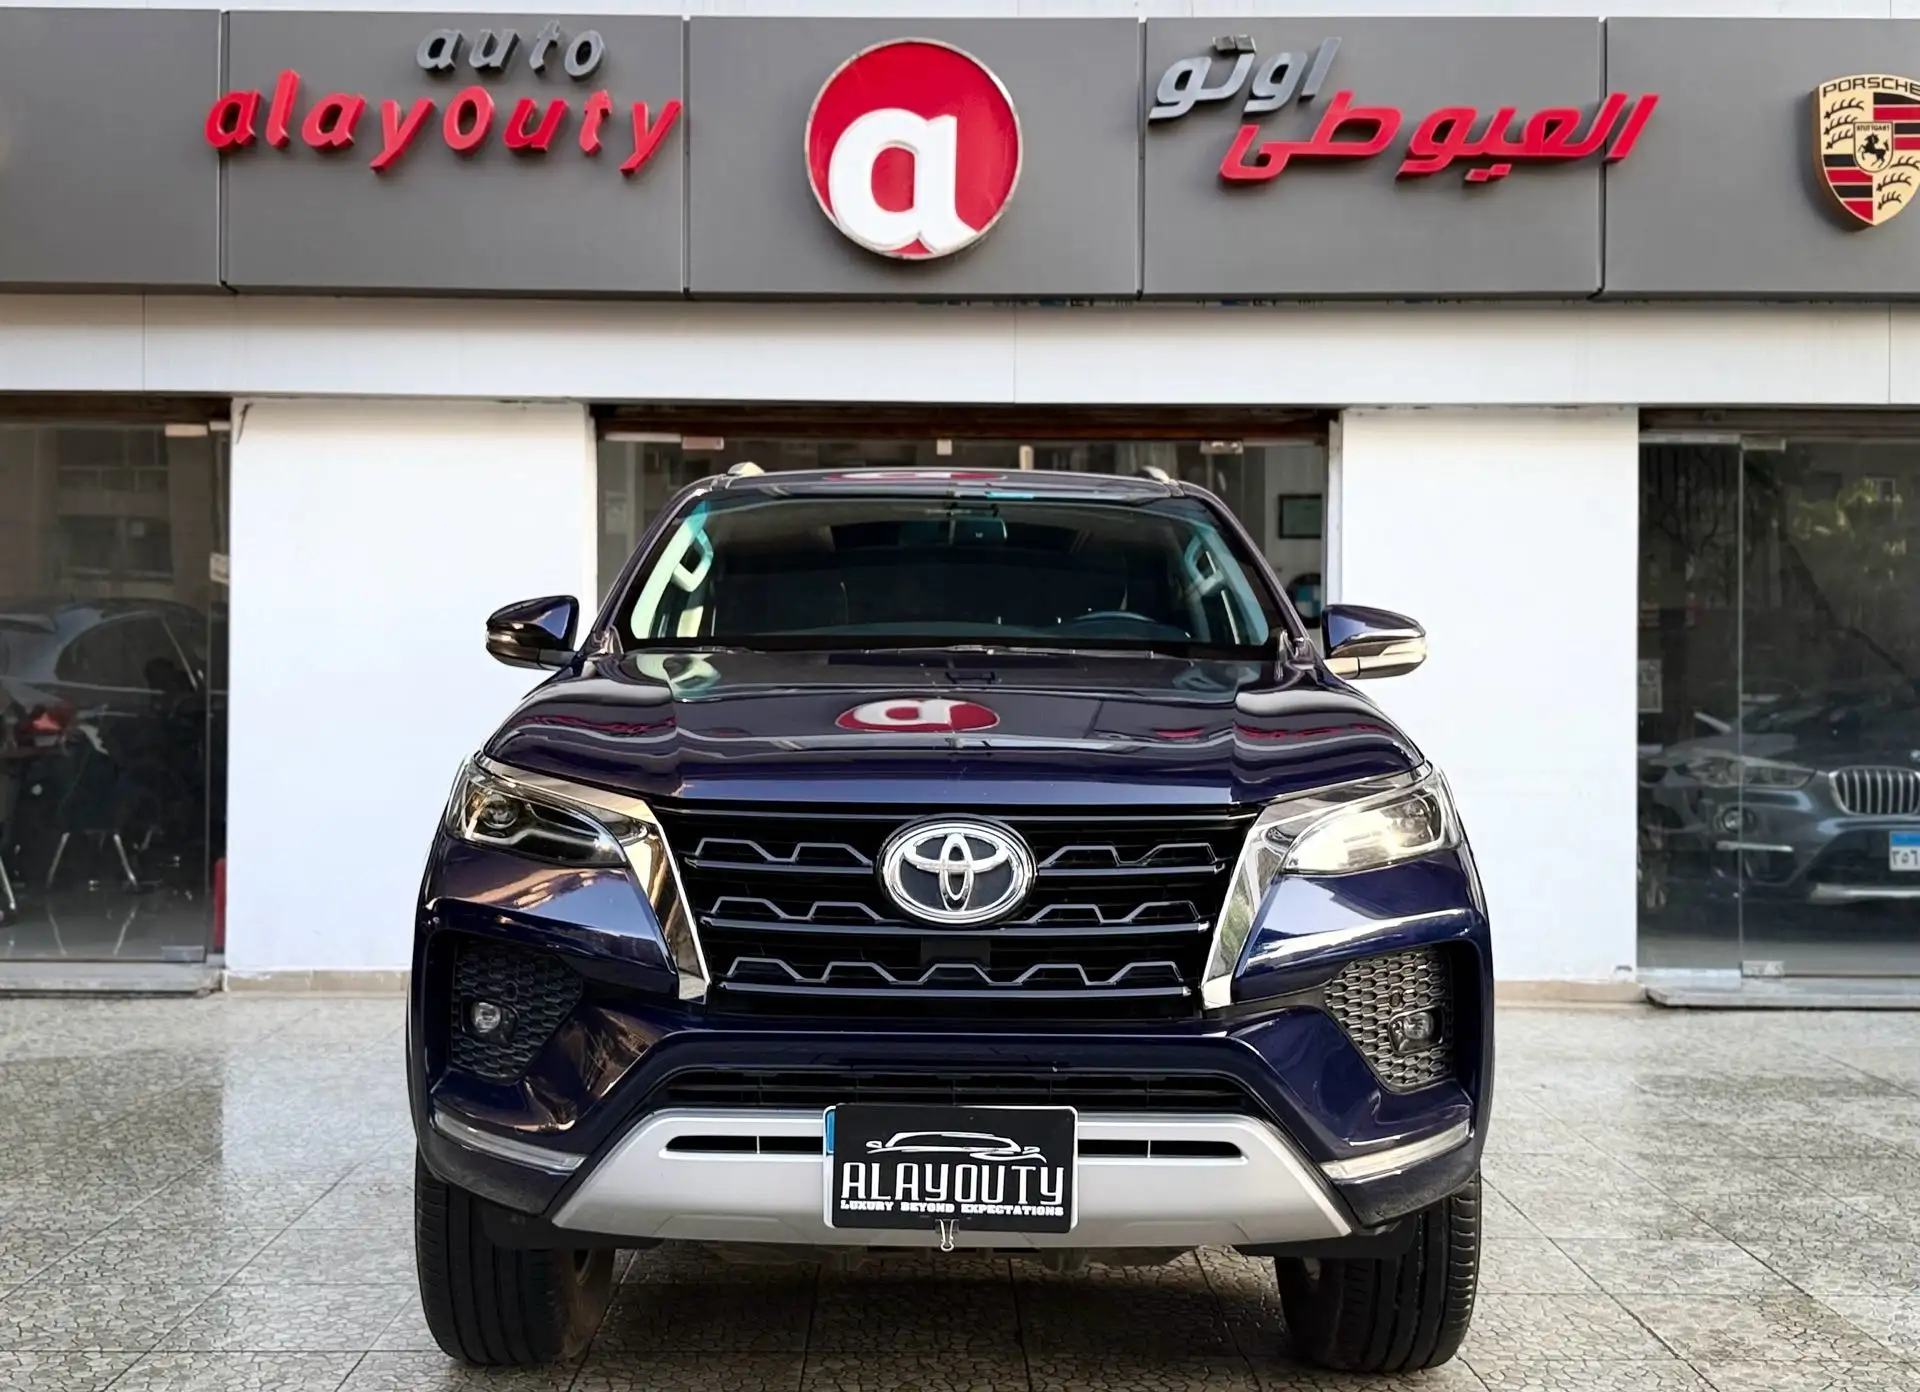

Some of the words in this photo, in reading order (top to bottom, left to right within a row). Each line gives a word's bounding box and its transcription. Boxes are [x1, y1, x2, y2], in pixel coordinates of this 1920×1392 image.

[415, 20, 606, 79] auto
[1823, 77, 1920, 98] PORSCHE
[205, 69, 682, 176] alayouty
[827, 107, 979, 252] a
[840, 1200, 894, 1212] LUXURY
[900, 1202, 955, 1214] BEYOND
[960, 1203, 1064, 1217] EXPECTATIONS
[841, 1162, 1064, 1205] ALAYOUTY
